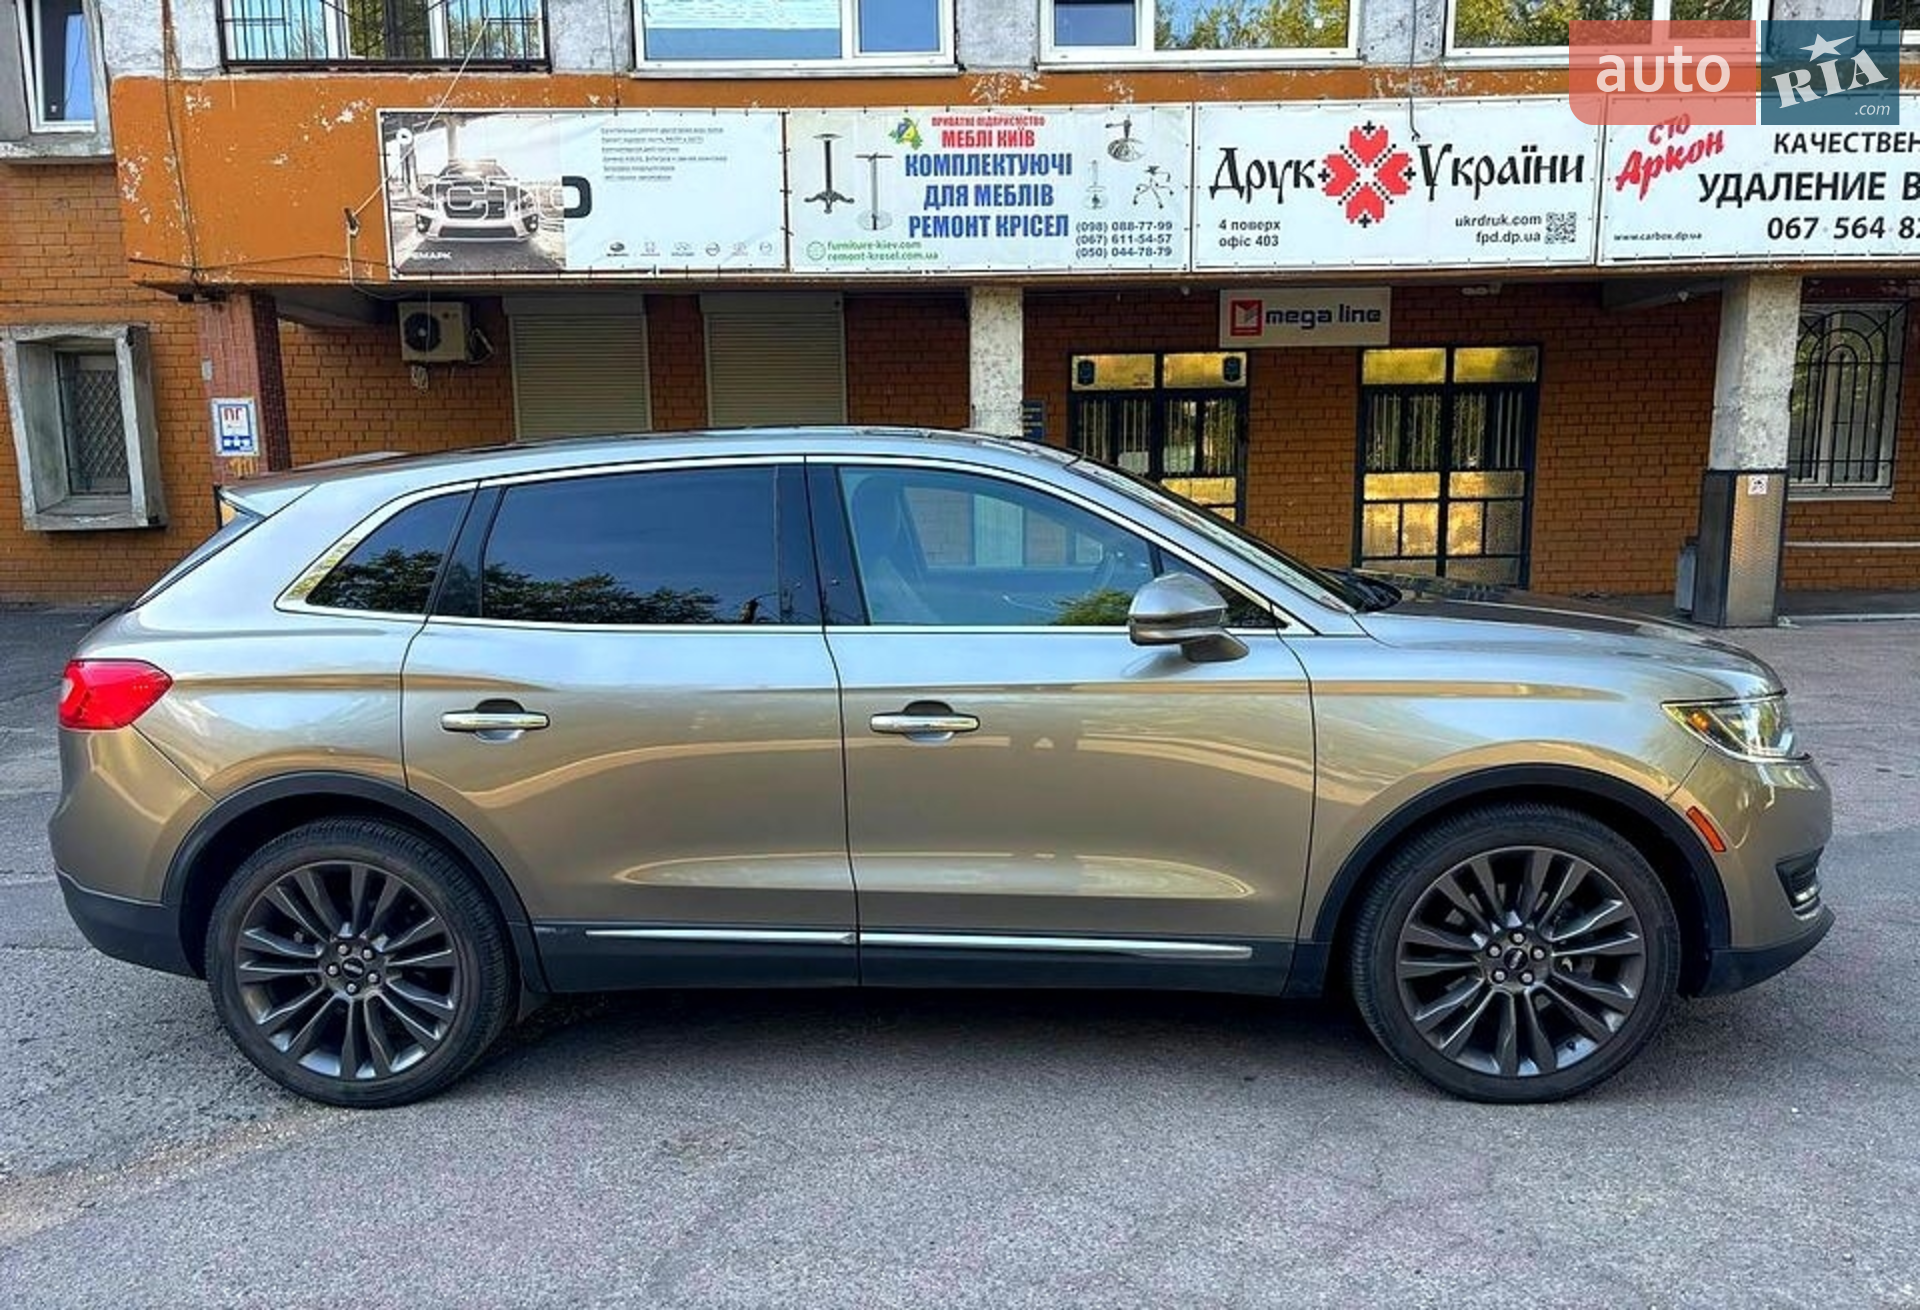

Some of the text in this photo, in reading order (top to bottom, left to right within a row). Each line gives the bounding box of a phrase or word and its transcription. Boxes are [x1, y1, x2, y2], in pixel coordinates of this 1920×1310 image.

[942, 126, 1035, 148] МЕБЛІ КИЇВ
[905, 153, 1073, 177] КОМПЛЕКТУЮЧІ
[1209, 144, 1585, 204] Друк України
[923, 184, 1055, 211] ДЛЯ МЕБЛІВ
[1698, 172, 1887, 208] УДАЛЕНИЕ
[909, 215, 1069, 239] РЕМОНТ КРІСЕЛ
[1218, 220, 1280, 234] 4 поверх
[1455, 214, 1542, 228] ukrdruk.com
[1767, 216, 1819, 240] 067
[1834, 216, 1886, 240] 564
[827, 241, 922, 250] furniture-kiev.com
[1076, 234, 1108, 246] (067)
[1219, 235, 1280, 250] офіс 403
[1475, 230, 1542, 245] fpd.dp.ua
[827, 251, 939, 261] remont-kresel.com.ua
[1076, 247, 1108, 259] (050)
[1266, 304, 1381, 330] mega line
